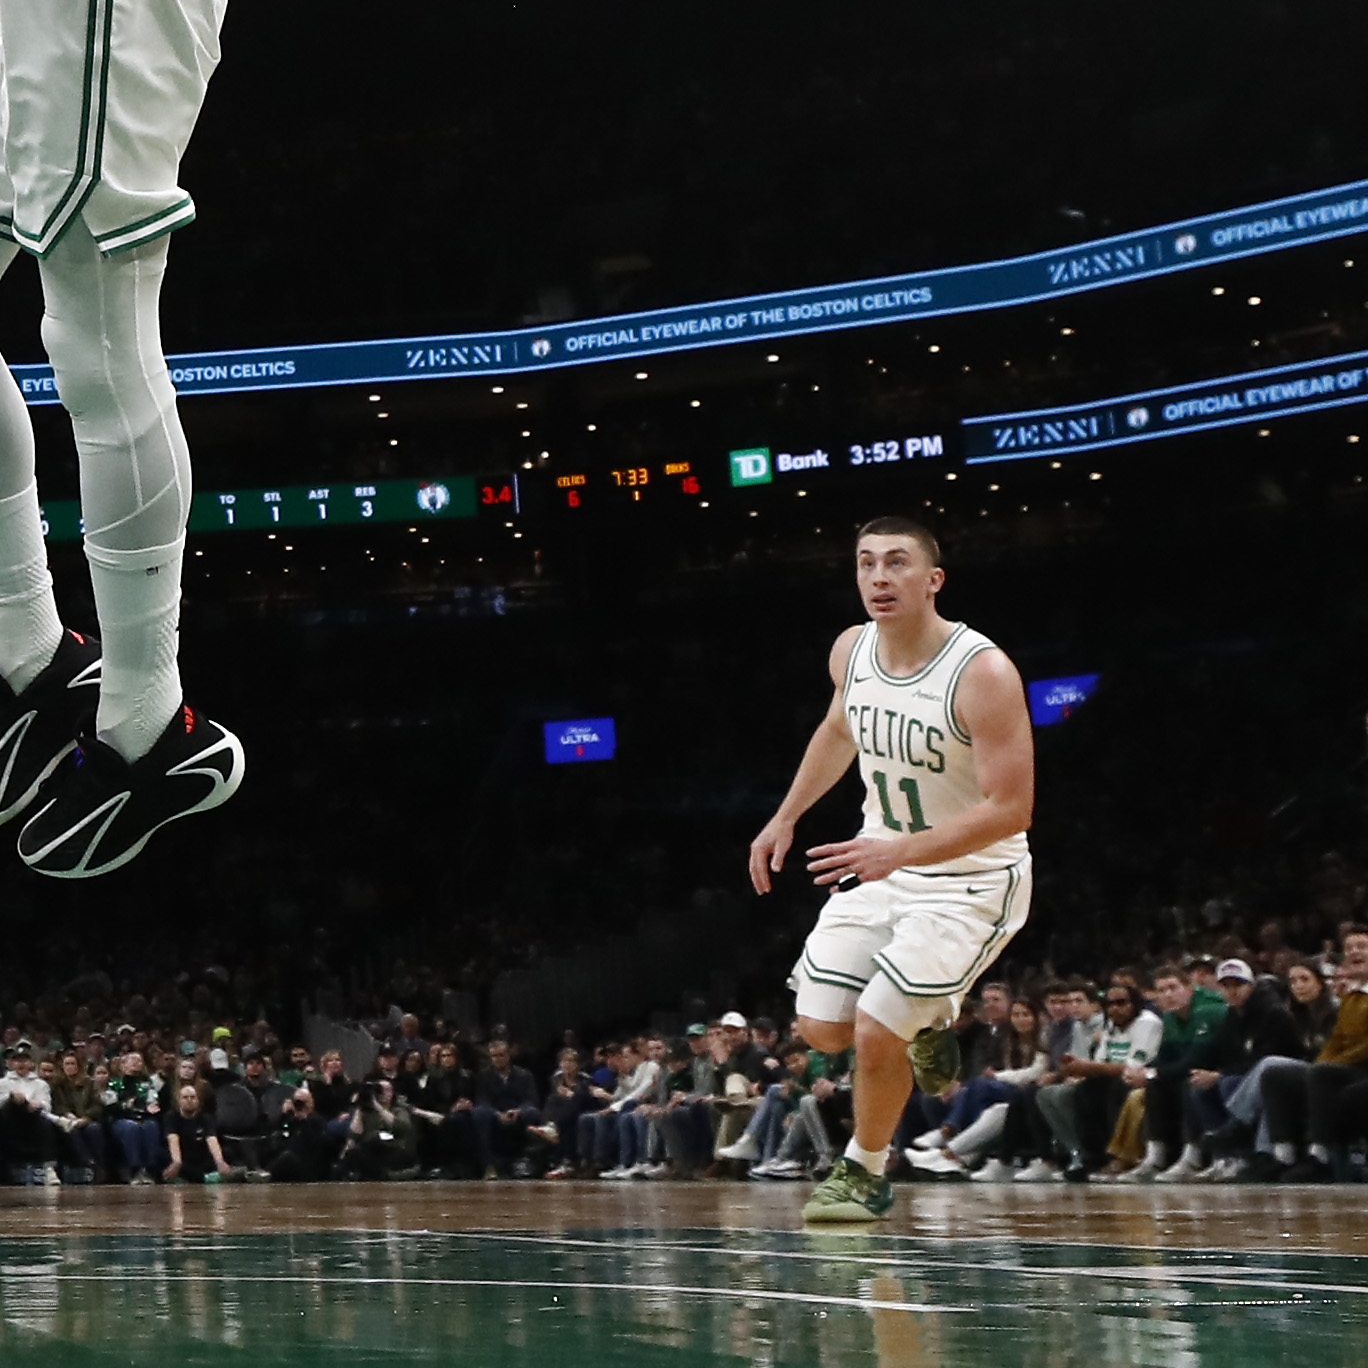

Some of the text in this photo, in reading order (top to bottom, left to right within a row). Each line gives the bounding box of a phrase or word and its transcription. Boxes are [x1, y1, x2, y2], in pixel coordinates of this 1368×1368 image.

[1210, 215, 1294, 248] OFFICIAL
[565, 287, 933, 352] OFFICIAL EYEWEAR OF THE BOSTON CELTICS
[168, 365, 227, 382] OSTON
[230, 360, 296, 379] CELTICS
[1162, 391, 1243, 422] OFFICIAL
[1245, 373, 1335, 405] EYEWEAR
[1336, 368, 1364, 391] OF
[735, 434, 944, 480] TD Bank 3:52 PM
[611, 467, 649, 487] 7:33
[219, 485, 377, 505] TO STL AST REB
[481, 485, 513, 505] 3.4
[227, 500, 373, 525] 1 1 1 3
[560, 732, 600, 745] ULTRA
[872, 769, 933, 835] 11
